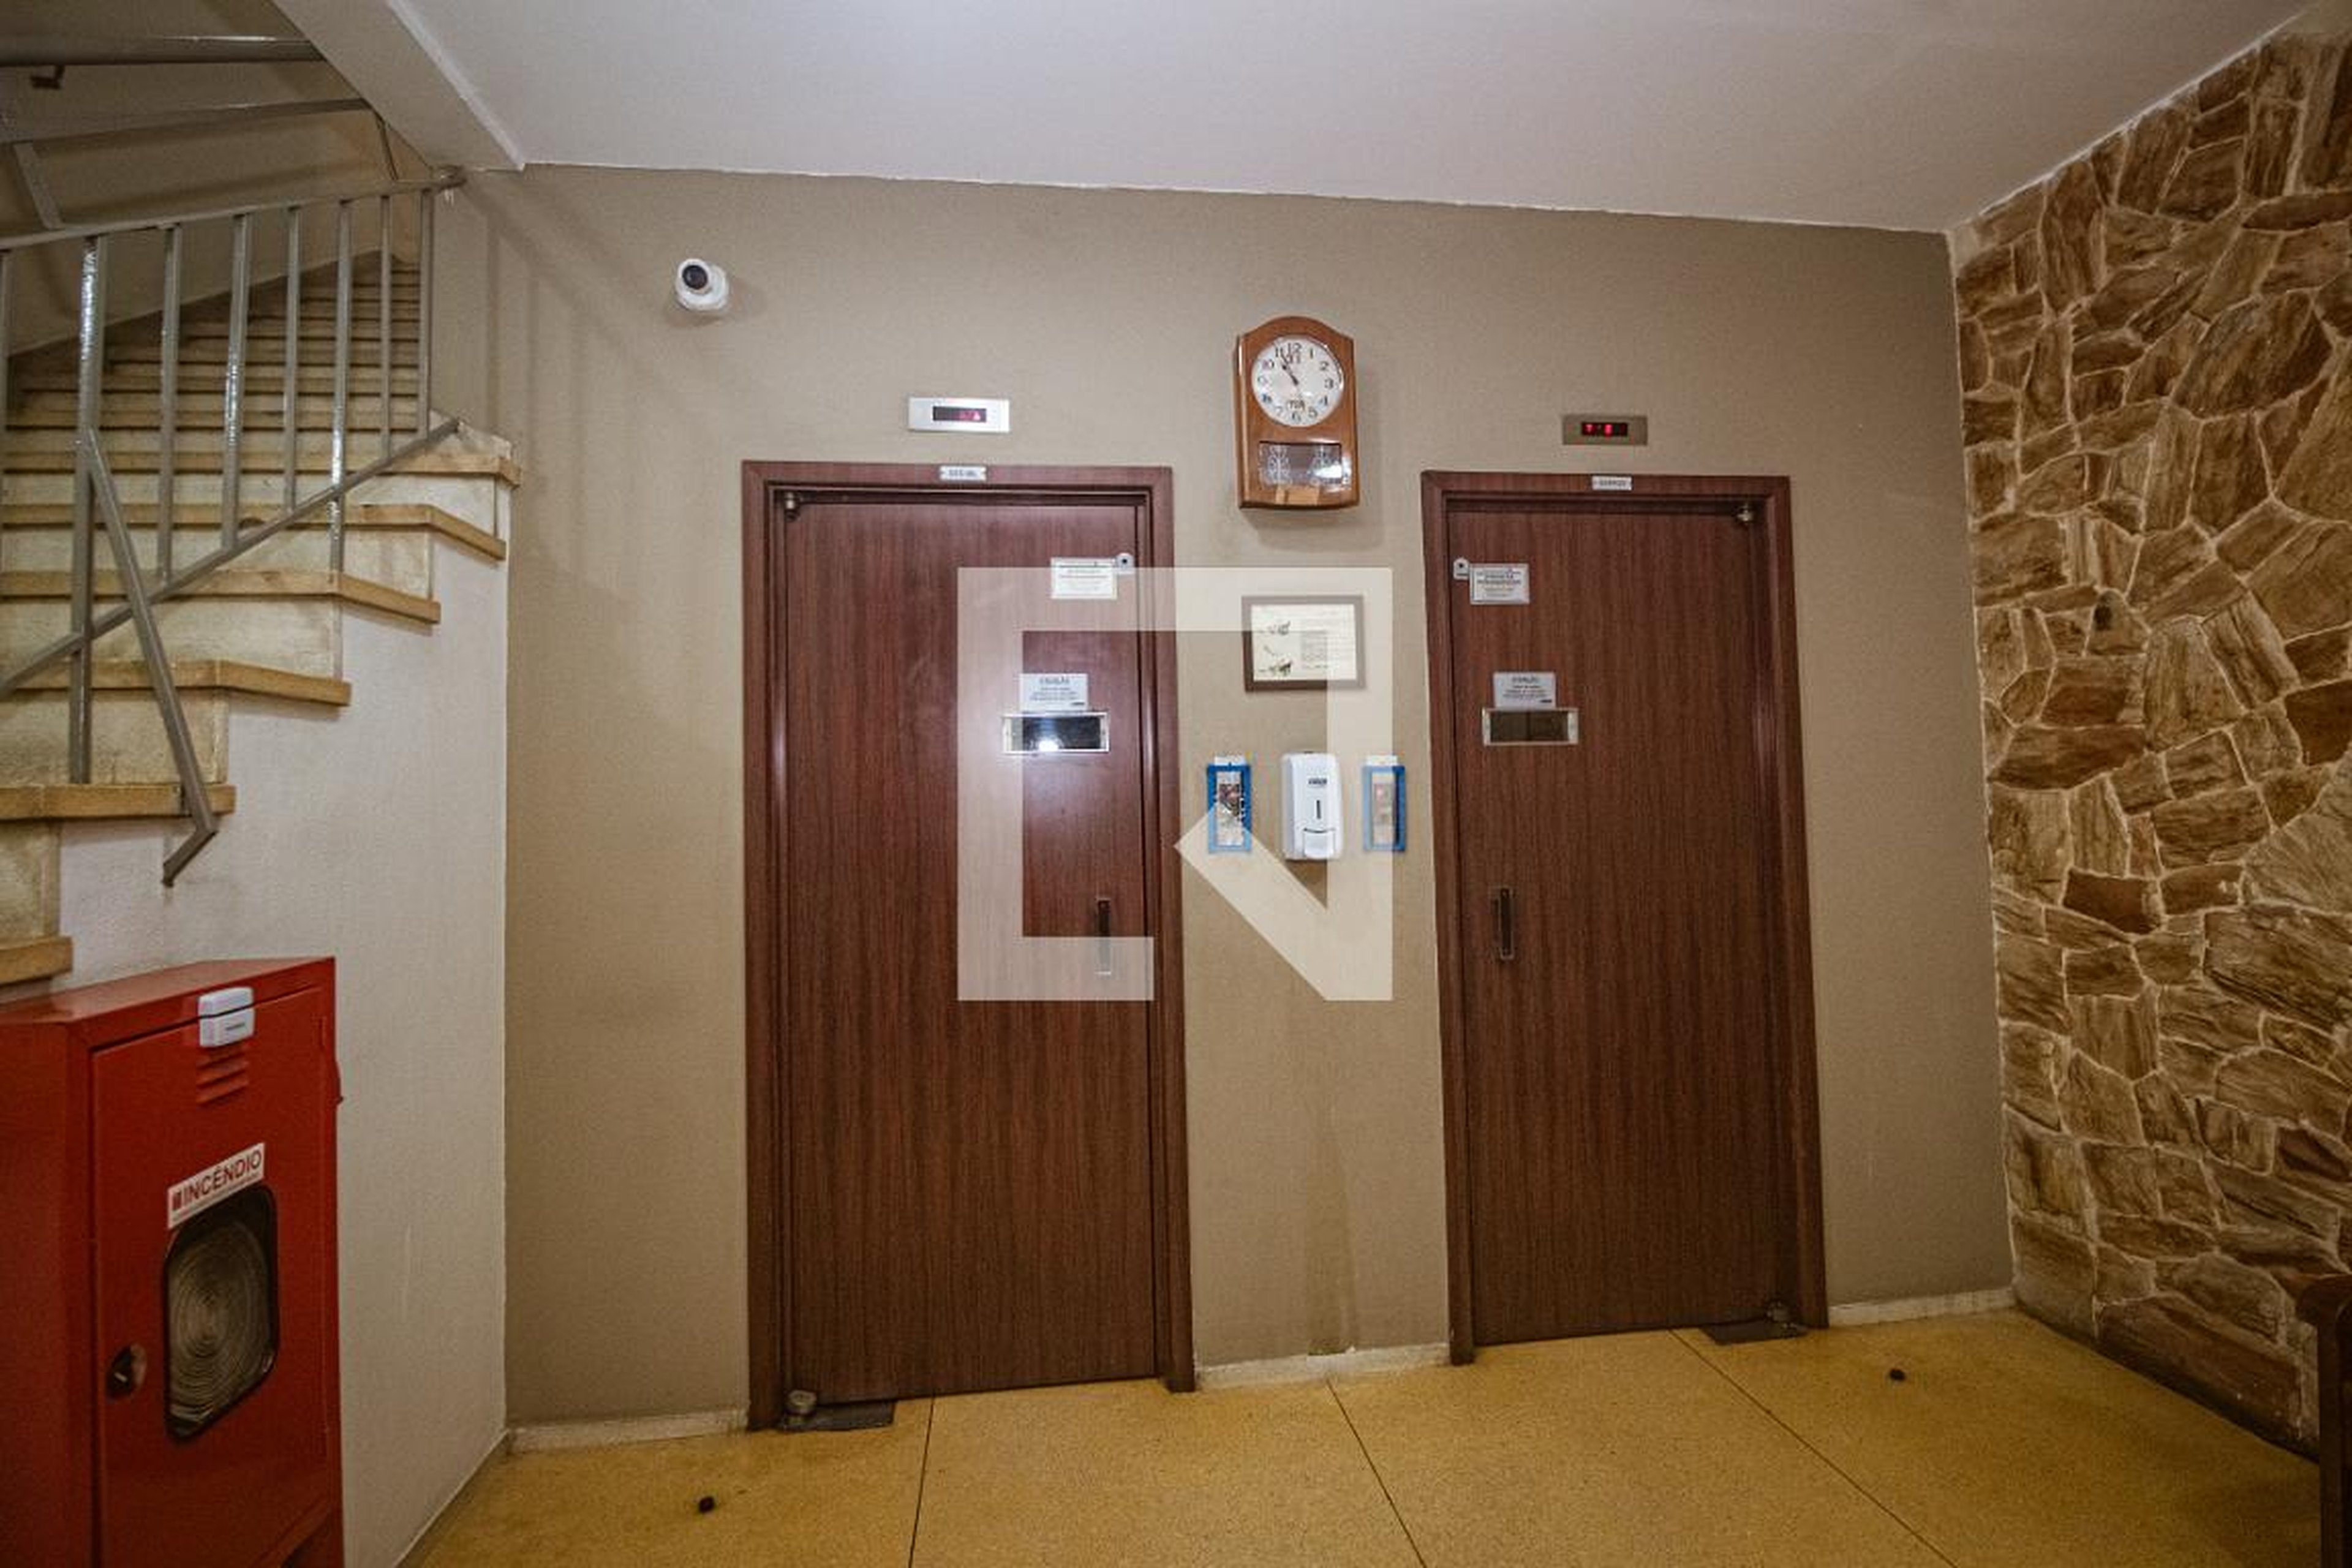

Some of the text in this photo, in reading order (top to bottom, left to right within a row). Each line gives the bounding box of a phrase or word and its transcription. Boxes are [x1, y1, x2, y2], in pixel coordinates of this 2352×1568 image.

[1289, 343, 1302, 353] 12
[1320, 361, 1329, 371] 2
[1324, 378, 1333, 389] 3
[184, 1150, 262, 1206] INCÊNDIO
